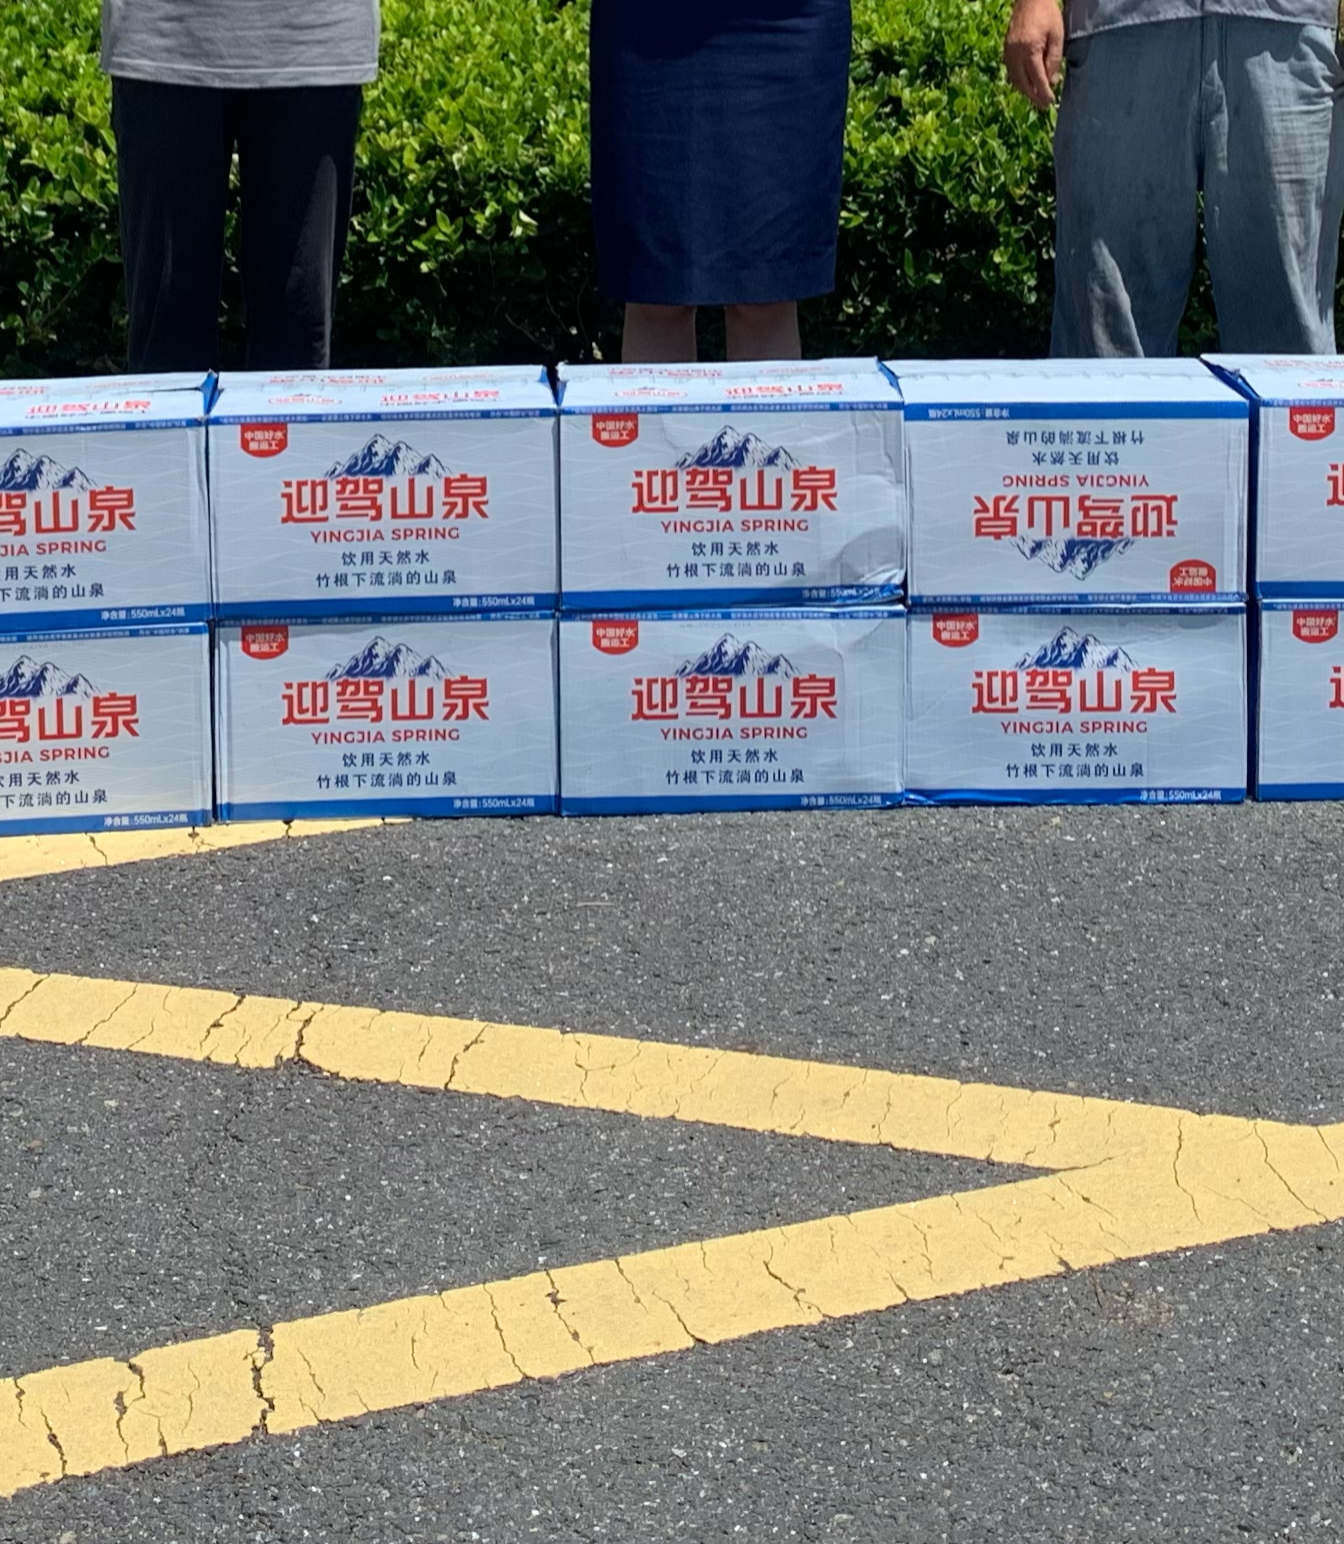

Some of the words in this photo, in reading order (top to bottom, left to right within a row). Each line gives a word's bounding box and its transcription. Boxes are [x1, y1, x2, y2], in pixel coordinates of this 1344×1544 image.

[1006, 430, 1144, 446] 竹根下流淌的山泉
[1032, 451, 1119, 465] 饮用天然水
[1003, 475, 1071, 487] SPRING
[1078, 474, 1149, 487] YINGJIA
[632, 466, 838, 513] 迎驾山泉
[281, 474, 489, 523] 迎驾山泉
[973, 494, 1178, 539] 迎驾山泉
[310, 528, 384, 543] YINGJIA
[391, 526, 461, 541] SPRING
[661, 521, 734, 533] YINGJIA
[741, 519, 810, 532] SPRING
[36, 539, 107, 555] SPRING
[691, 542, 779, 557] 饮用天然水
[341, 550, 430, 565] 饮用天然水
[315, 569, 456, 588] 竹根下流淌的山泉
[666, 562, 806, 579] 竹根下流淌的山泉
[632, 674, 838, 721] 迎驾山泉
[972, 668, 1177, 715] 迎驾山泉
[282, 676, 489, 725] 迎驾山泉
[661, 728, 733, 741] YINGJIA
[740, 727, 808, 740] SPRING
[1001, 721, 1074, 734] YINGJIA
[1081, 720, 1148, 734] SPRING
[311, 730, 385, 745] YINGJIA
[392, 728, 461, 743] SPRING
[39, 746, 110, 763] SPRING
[691, 749, 778, 764] 饮用天然水
[1031, 743, 1118, 757] 饮用天然水
[342, 751, 430, 768] 饮用天然水
[665, 768, 804, 785] 竹根下流淌的山泉
[1006, 763, 1144, 779] 竹根下流淌的山泉
[316, 771, 456, 789] 竹根下流淌的山泉
